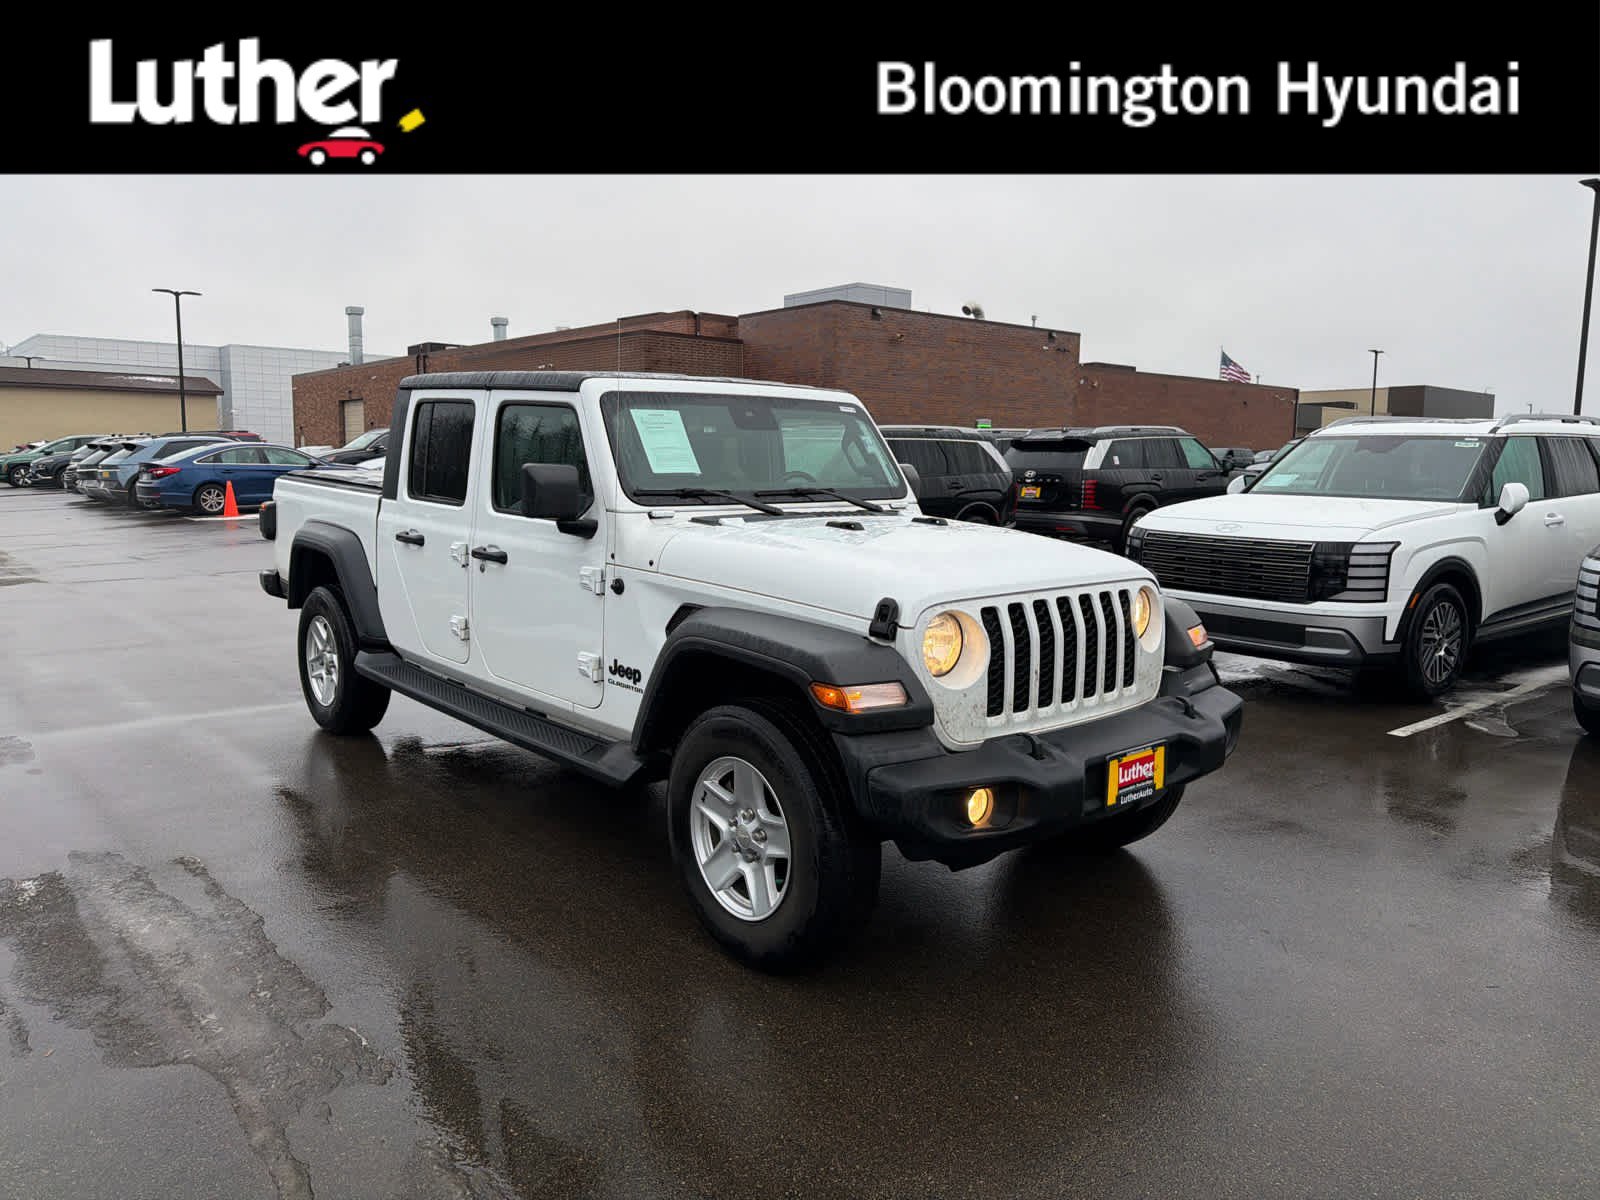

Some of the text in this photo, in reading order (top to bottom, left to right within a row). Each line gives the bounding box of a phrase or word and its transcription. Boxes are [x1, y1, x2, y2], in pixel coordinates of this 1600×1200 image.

[608, 658, 642, 686] Jeep
[1118, 761, 1154, 784] Luther
[1120, 787, 1153, 804] LutherAuto
